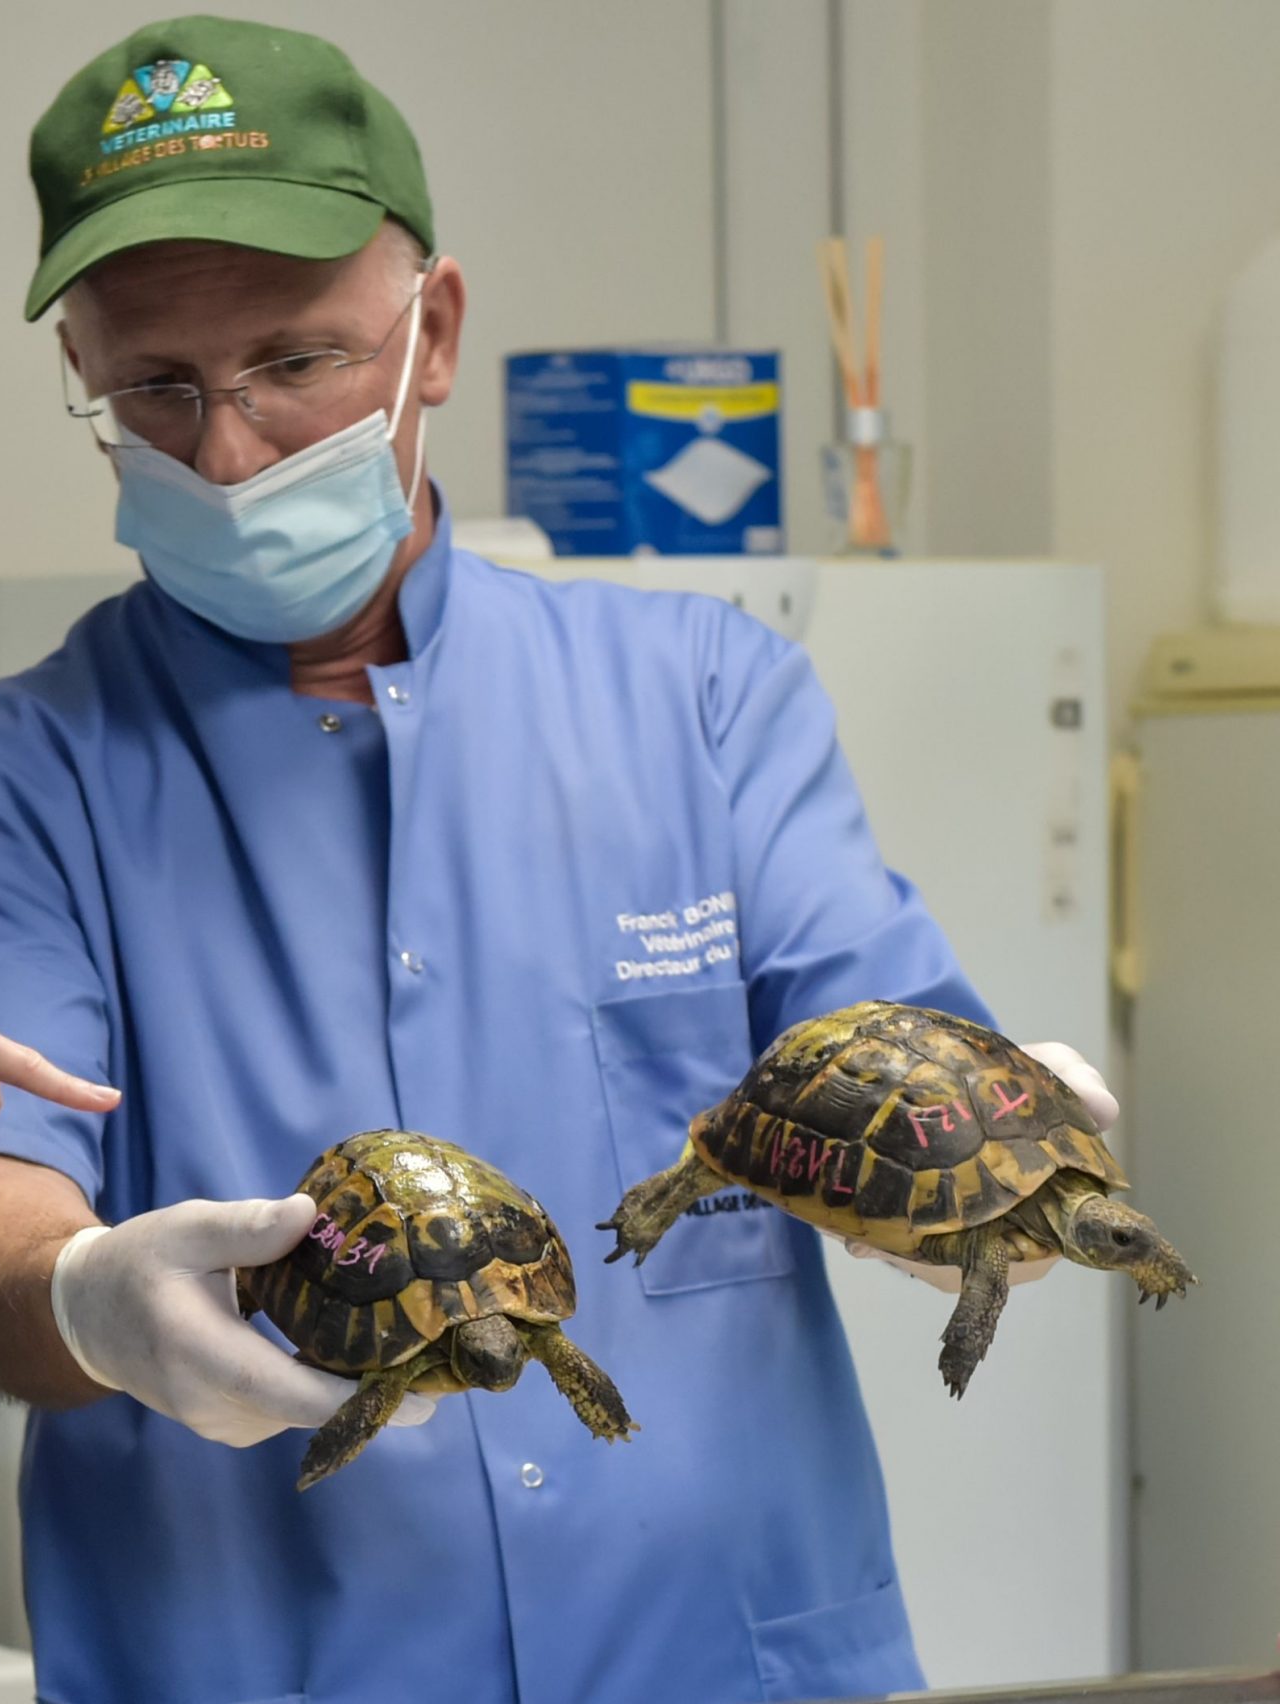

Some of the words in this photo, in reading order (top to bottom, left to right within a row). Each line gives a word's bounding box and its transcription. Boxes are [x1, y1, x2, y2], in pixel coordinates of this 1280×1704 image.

[154, 137, 186, 159] DES
[615, 956, 701, 981] Directeur
[705, 944, 733, 965] du
